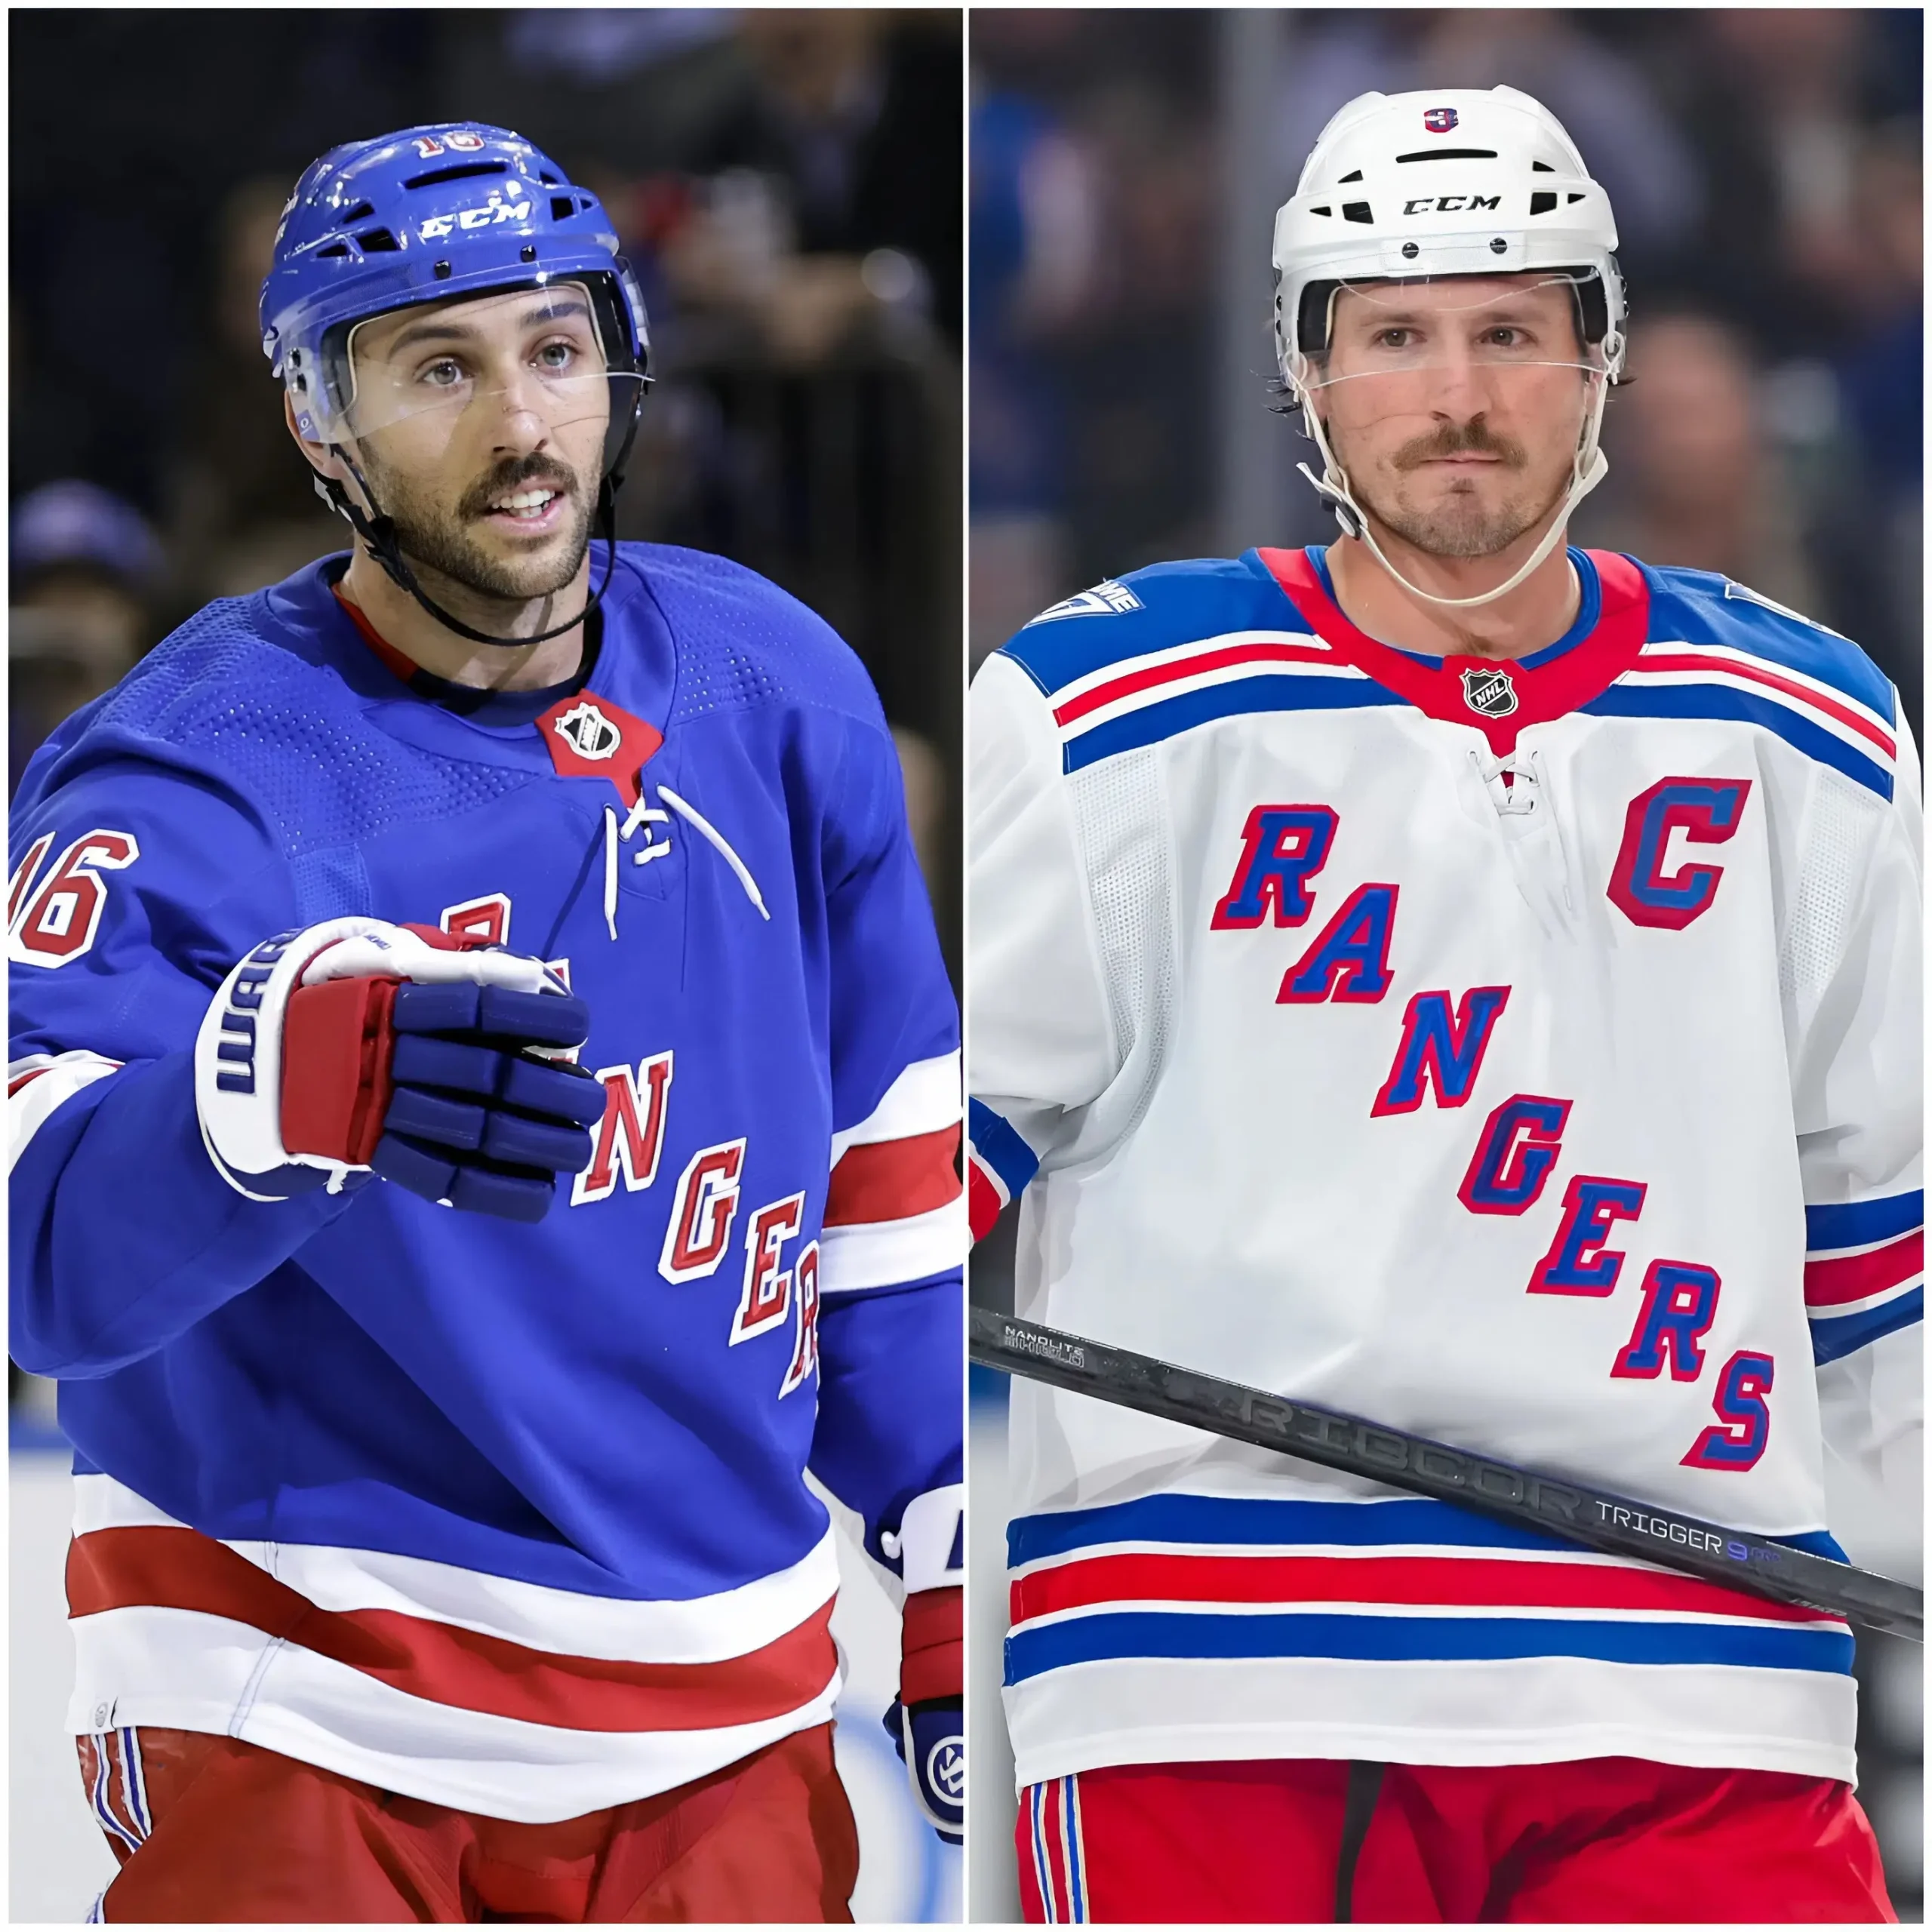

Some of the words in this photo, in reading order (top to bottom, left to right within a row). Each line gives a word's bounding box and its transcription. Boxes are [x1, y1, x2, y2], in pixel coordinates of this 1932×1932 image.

[420, 201, 531, 238] CCM
[1402, 195, 1503, 216] CCM
[1475, 681, 1506, 707] NHL
[8, 829, 140, 970] 16
[1606, 776, 1752, 931] C
[1210, 804, 1774, 1472] RANGERS
[1240, 1390, 1583, 1520] RIBCOR
[1595, 1500, 1723, 1555] TRIGGER
[1727, 1541, 1749, 1561] 9
